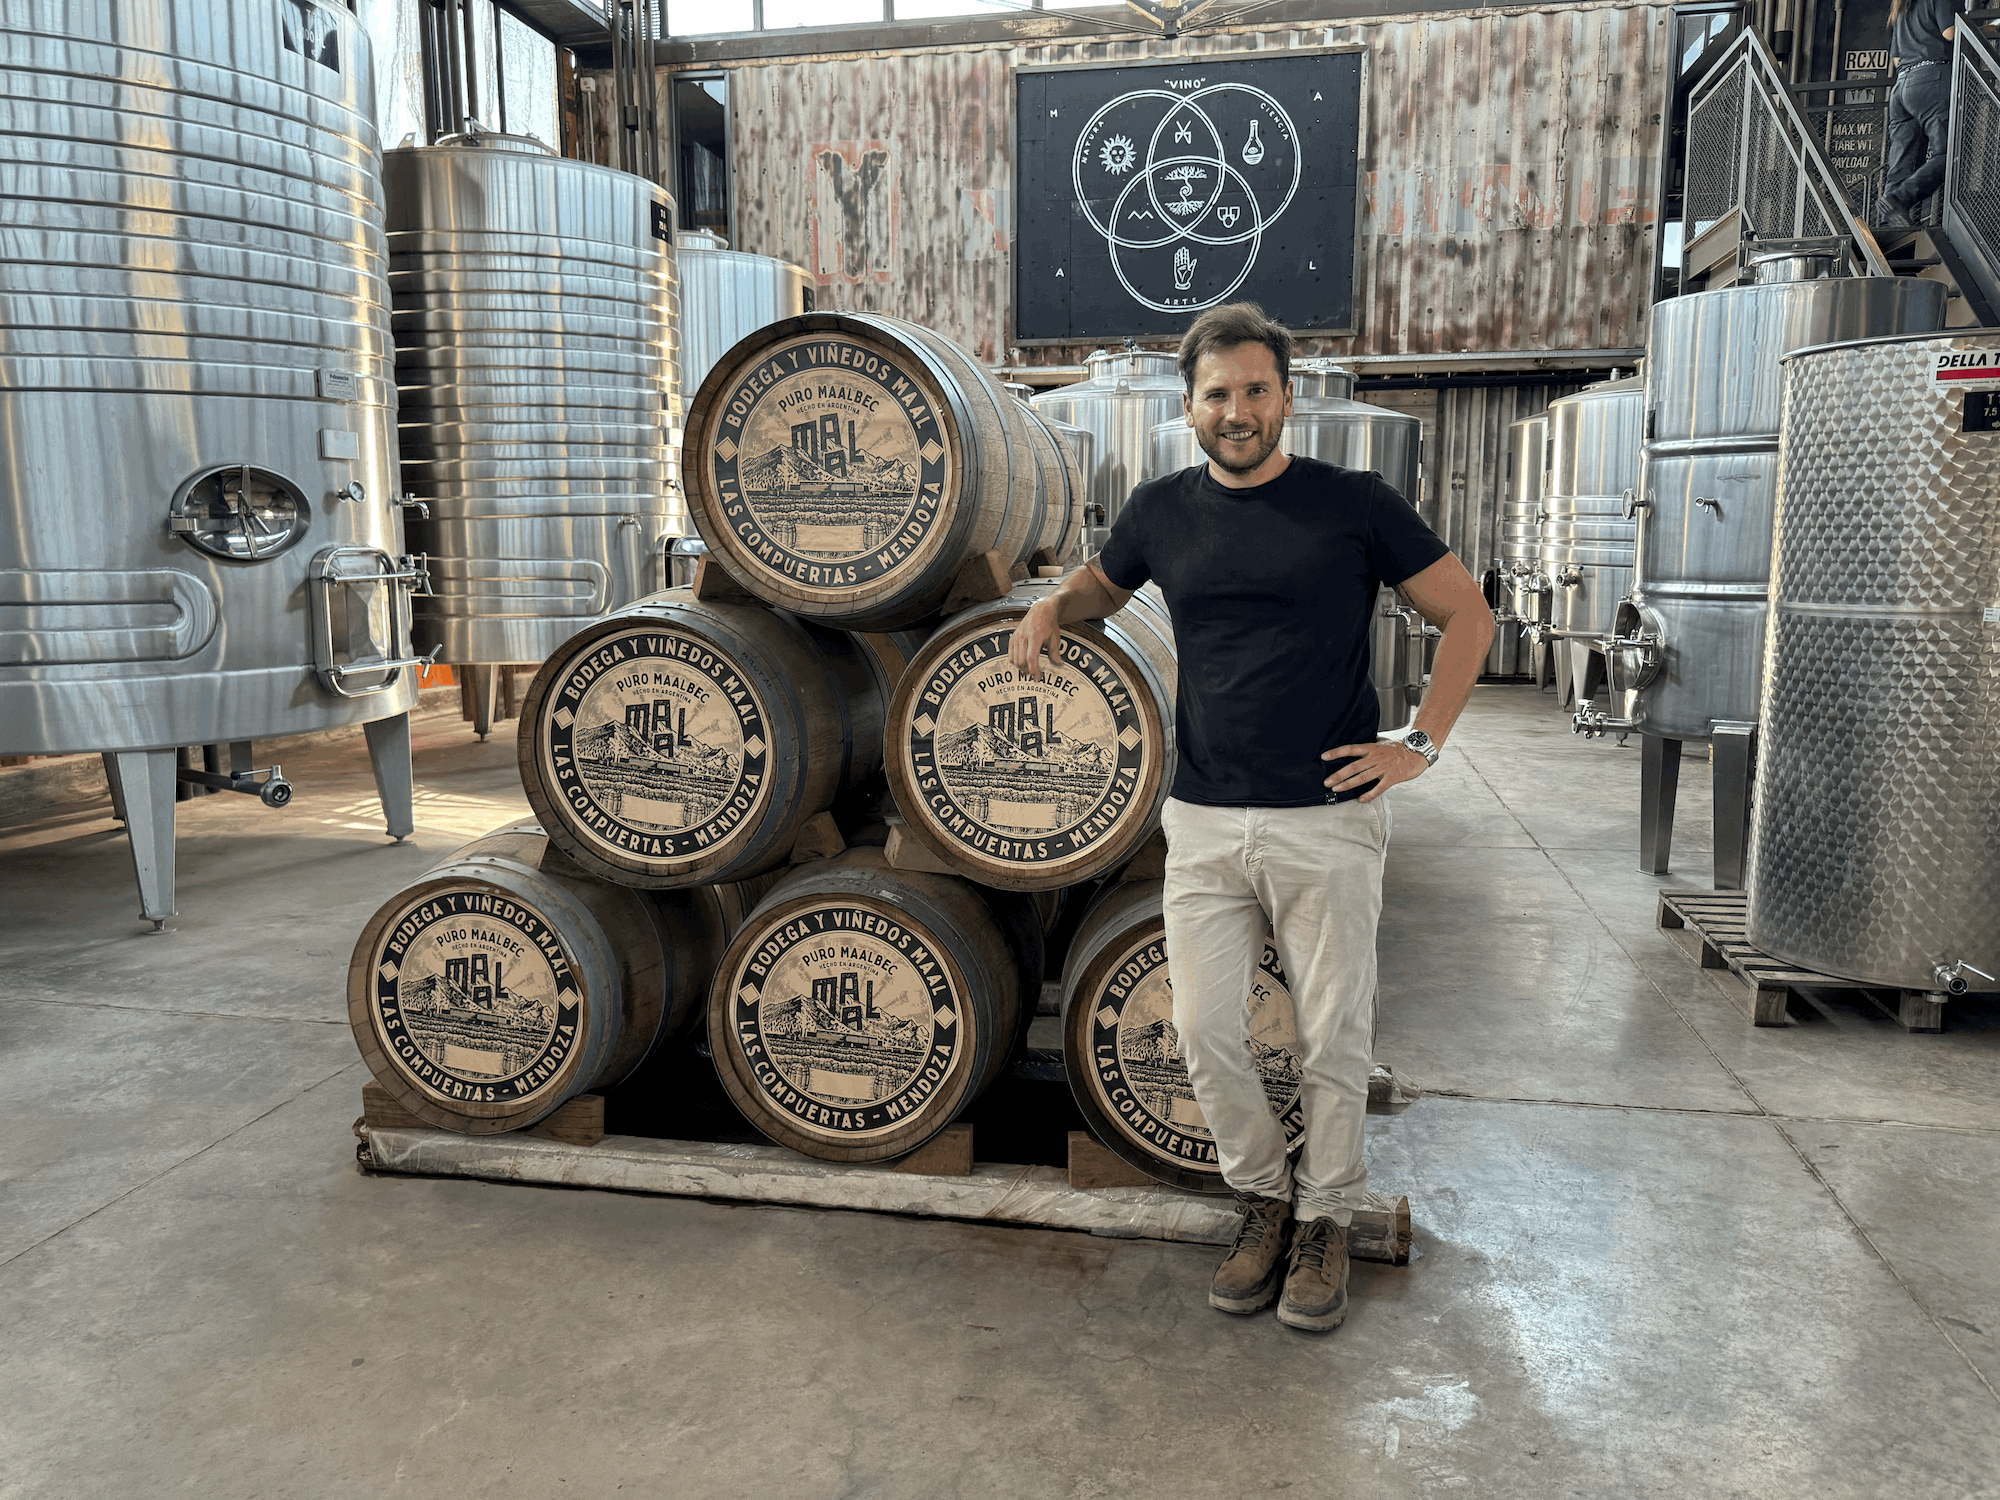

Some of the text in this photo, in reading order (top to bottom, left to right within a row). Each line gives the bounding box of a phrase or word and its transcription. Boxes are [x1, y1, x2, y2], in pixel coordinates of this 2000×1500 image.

[1846, 52, 1887, 69] RCXU
[1314, 92, 1323, 101] A
[1050, 110, 1058, 118] M
[1260, 102, 1289, 140] CIENCIA
[1081, 121, 1105, 164] NATURA
[1834, 140, 1855, 151] TARE
[1831, 156, 1869, 169] PAYLOAD
[1056, 268, 1065, 277] A
[1310, 261, 1317, 270] L
[1164, 297, 1197, 306] ARTE
[1937, 353, 1987, 368] DELLA
[726, 361, 784, 428] BODEGA
[788, 351, 798, 368] Y
[807, 343, 891, 381] VIÑEDOS
[892, 376, 930, 429] MAAL
[778, 386, 879, 413] PURO MAALBEC
[796, 404, 815, 415] HECHO
[828, 403, 860, 415] ARGENTINA
[1984, 407, 1998, 417] 7.5
[720, 479, 743, 516] LAS
[738, 522, 857, 585] COMPUERTAS
[877, 483, 940, 569] MENDOZA
[565, 637, 757, 725] BODEGA Y VIÑEDOS MAAL
[616, 673, 710, 703] PURO MAALBEC
[924, 644, 986, 705] BODEGA
[990, 636, 1000, 652] Y
[1093, 665, 1131, 716] MAAL
[978, 671, 1013, 693] PURO
[632, 688, 650, 696] HECHO
[662, 690, 691, 704] ARGENTINA
[996, 686, 1015, 695] HECHO
[1027, 686, 1059, 699] ARGENTINA
[554, 745, 574, 779] LAS
[568, 786, 674, 854] COMPUERTAS
[694, 775, 760, 846] MENDOZA
[915, 753, 937, 789] LAS
[931, 795, 1048, 859] COMPUERTAS
[1069, 768, 1137, 848] MENDOZA
[390, 895, 571, 978] BODEGA Y VIÑEDOS MAAL
[436, 929, 525, 958] PURO MAALBEC
[479, 944, 507, 958] ARGENTINA
[751, 908, 946, 996] BODEGA Y VIÑEDOS MAAL
[802, 947, 898, 975] PURO MAALBEC
[849, 962, 879, 976] ARGENTINA
[381, 997, 400, 1029] LAS
[395, 1036, 495, 1101] COMPUERTAS
[514, 1026, 574, 1094] MENDOZA
[740, 1021, 761, 1057] LAS
[755, 1062, 865, 1128] COMPUERTAS
[886, 1046, 951, 1120] MENDOZA
[1097, 1045, 1218, 1162] LAS COMPUERTA
